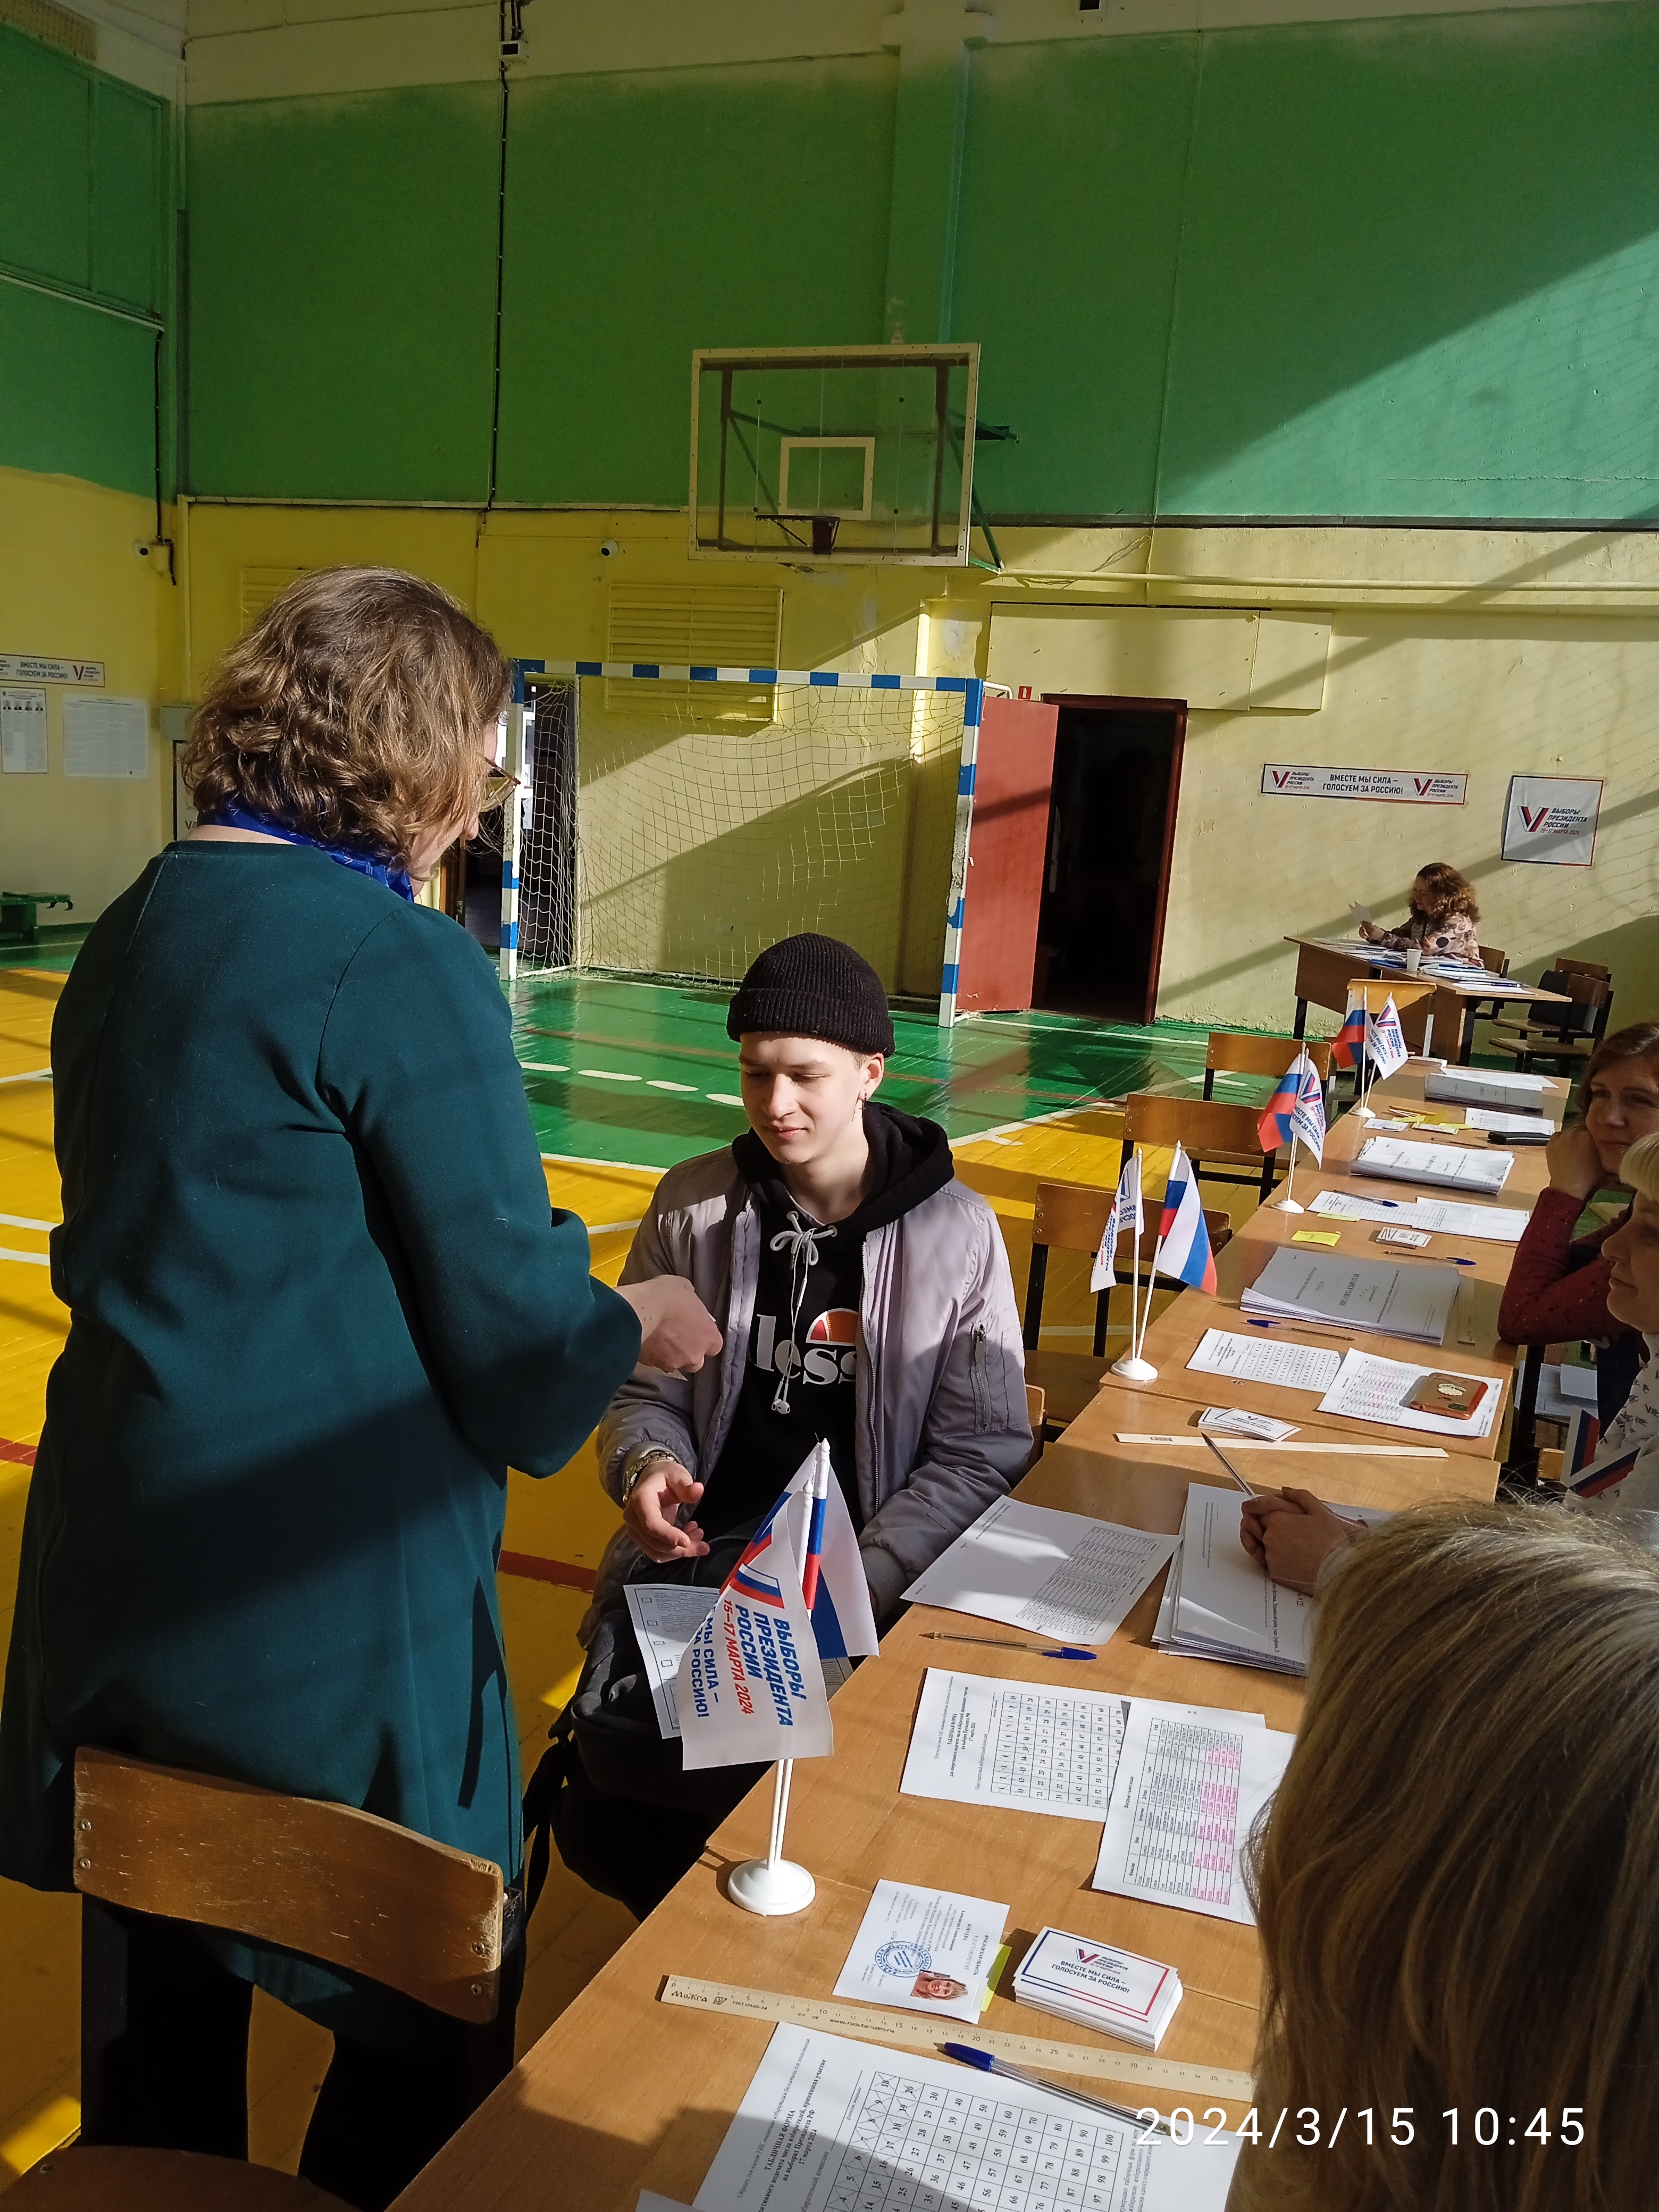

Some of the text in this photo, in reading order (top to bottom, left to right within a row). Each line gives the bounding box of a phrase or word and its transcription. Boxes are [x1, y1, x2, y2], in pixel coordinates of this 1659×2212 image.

[1322, 783, 1359, 792] ГОЛОСУЕМ
[1371, 785, 1403, 794] РОССИЮ!
[704, 1617, 714, 1644] МЫ
[735, 1604, 763, 1680] РОССИИ
[726, 1637, 745, 1681] МАРТА
[774, 1618, 807, 1700] ВЫБОРЫ
[703, 1648, 719, 1690] СИЛА
[753, 1611, 794, 1726] ПРЕЗИДЕНТА
[691, 1648, 709, 1717] РОССИЮ!
[735, 1683, 755, 1715] 2024
[1060, 1960, 1086, 1972] ВМЕСТЕ
[1101, 1974, 1120, 1983] СИЛА
[1052, 1964, 1087, 1979] ГОЛОСУЕМ
[1098, 1979, 1130, 1993] РОССИЮ!
[929, 2092, 939, 2101] 30
[954, 2098, 963, 2106] 40
[979, 2104, 988, 2113] 50
[807, 2109, 816, 2119] РФ
[923, 2110, 933, 2119] 29
[1003, 2110, 1012, 2119] 60
[948, 2116, 957, 2125] 39
[974, 2123, 982, 2131] 49
[1054, 2123, 1063, 2132] 80
[807, 2128, 817, 2142] 2024
[917, 2129, 927, 2138] 28
[998, 2129, 1007, 2138] 59
[1079, 2130, 1088, 2138] 90
[764, 2108, 795, 2172] ТАБЛИЧНАЯ ФОРМА
[942, 2134, 952, 2144] 38
[1024, 2135, 1033, 2144] 69
[1104, 2134, 1114, 2146] 100
[802, 2141, 814, 2158] марта
[968, 2141, 977, 2150] 48
[1049, 2142, 1059, 2150] 79
[911, 2147, 920, 2157] 27
[993, 2148, 1002, 2157] 58
[1075, 2148, 1084, 2157] 89
[936, 2154, 945, 2164] 37
[1019, 2155, 1028, 2164] 68
[1101, 2155, 1110, 2164] 99
[962, 2160, 971, 2170] 47
[1045, 2161, 1054, 2169] 78
[904, 2167, 914, 2176] 26
[987, 2167, 997, 2177] 57
[1071, 2168, 1080, 2177] 88
[930, 2174, 940, 2184] 36
[1014, 2174, 1023, 2184] 67
[1097, 2174, 1106, 2184] 98
[957, 2181, 966, 2190] 46
[1040, 2181, 1049, 2190] 77
[898, 2186, 907, 2197] 25
[982, 2188, 992, 2198] 56
[1066, 2188, 1075, 2197] 87
[924, 2194, 933, 2203] 35
[1009, 2195, 1018, 2204] 66
[1093, 2194, 1102, 2203] 97
[950, 2201, 960, 2211] 45
[1035, 2202, 1045, 2210] 76
